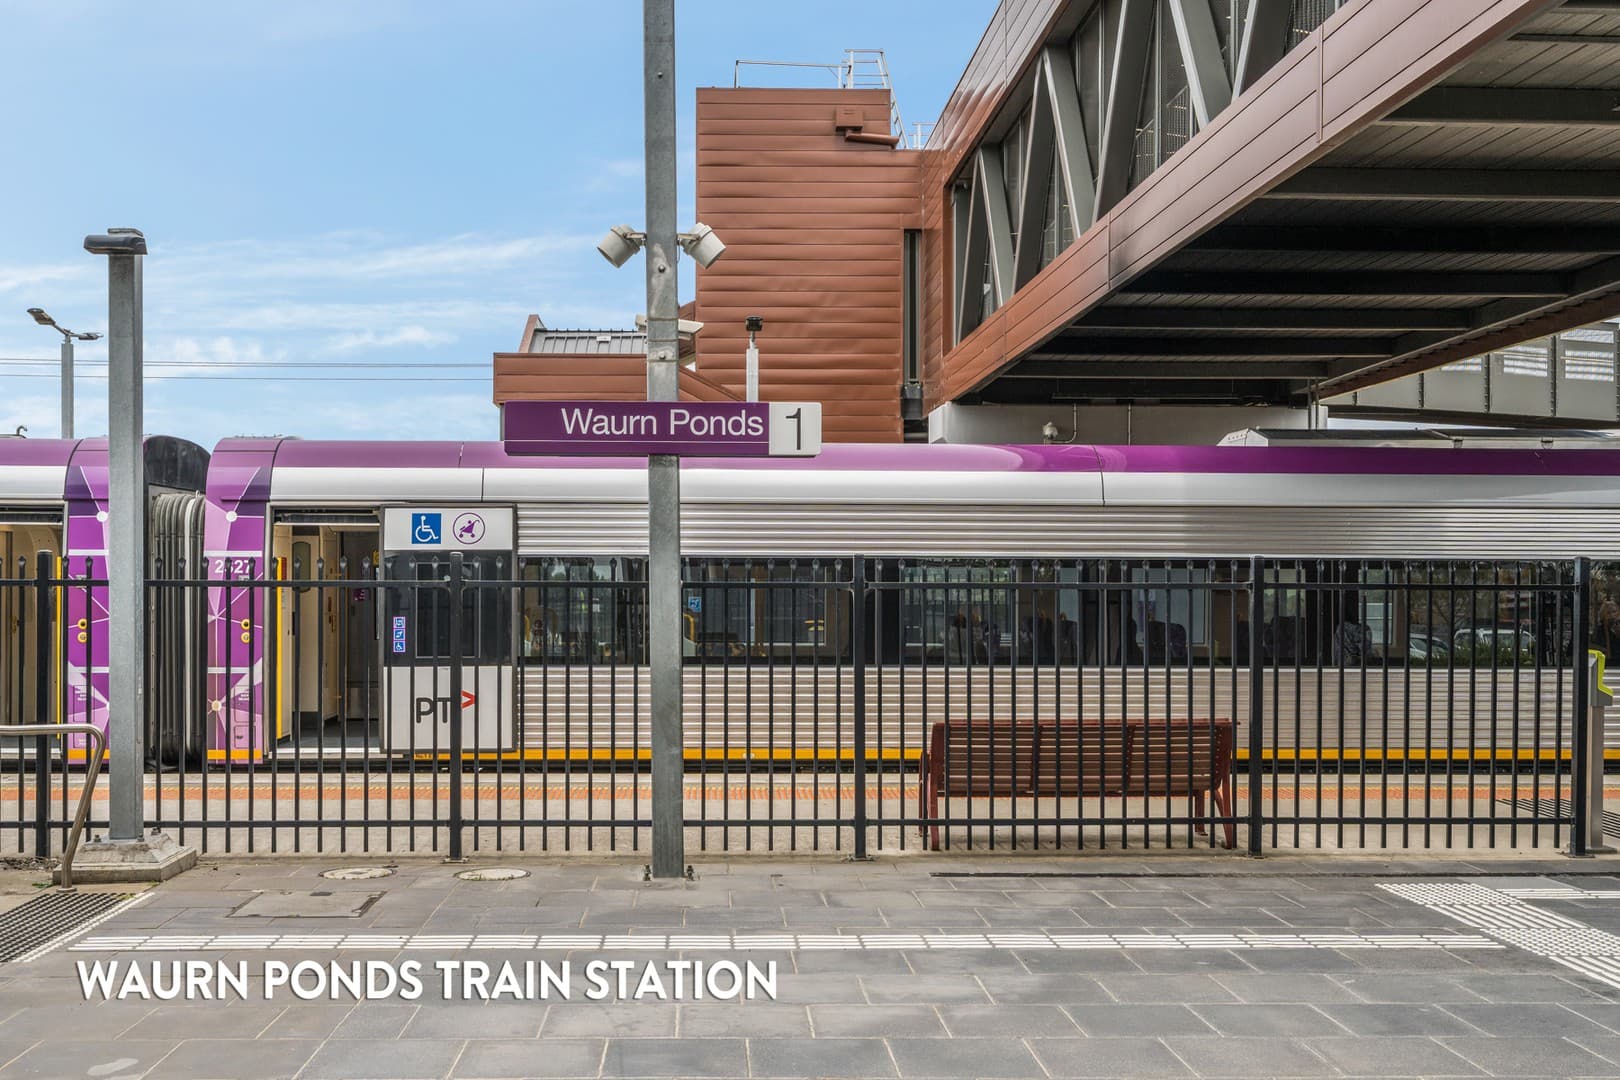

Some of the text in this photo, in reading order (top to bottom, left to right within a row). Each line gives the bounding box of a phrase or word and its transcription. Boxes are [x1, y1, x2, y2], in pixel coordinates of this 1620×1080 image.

[561, 407, 764, 436] Waurn Ponds
[785, 407, 801, 451] 1
